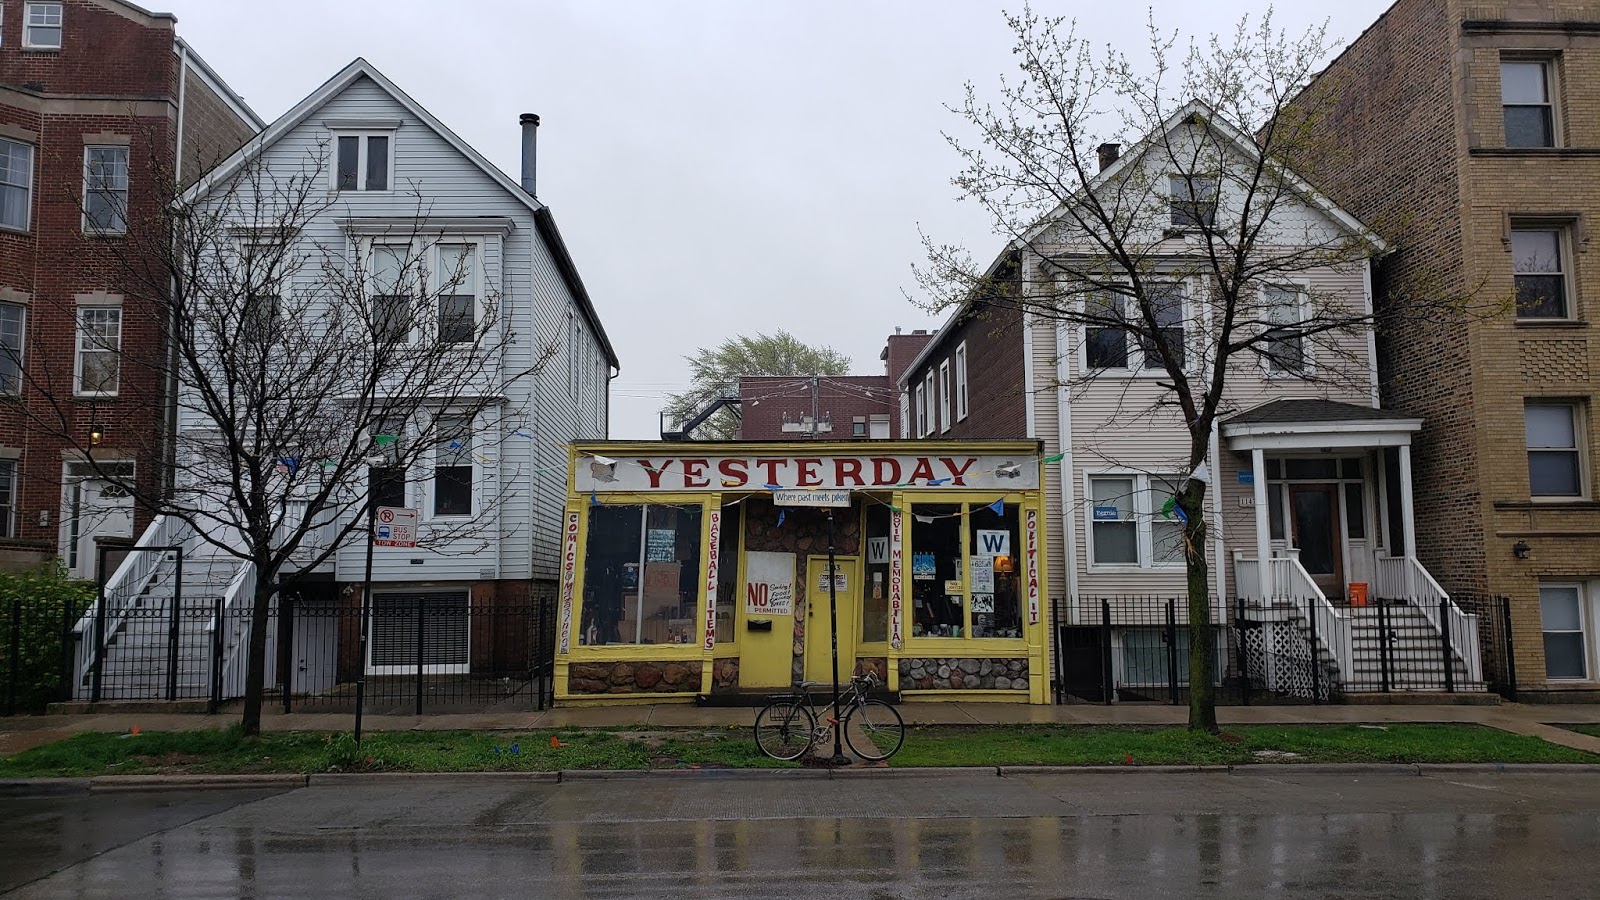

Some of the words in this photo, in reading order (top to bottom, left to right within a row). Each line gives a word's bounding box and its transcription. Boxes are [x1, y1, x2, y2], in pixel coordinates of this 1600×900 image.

[637, 458, 977, 488] YESTERDAY
[776, 493, 796, 502] Where
[798, 493, 812, 503] past
[812, 493, 830, 502] meets
[892, 511, 902, 542] MOVIE
[565, 514, 577, 571] COMICS
[707, 513, 719, 591] BASEBALL
[871, 541, 885, 559] W
[982, 534, 1005, 552] W
[1027, 511, 1038, 598] POLITICAL
[747, 582, 769, 607] NO
[892, 550, 901, 641] MEMORABILIA
[705, 600, 715, 648] ITEMS
